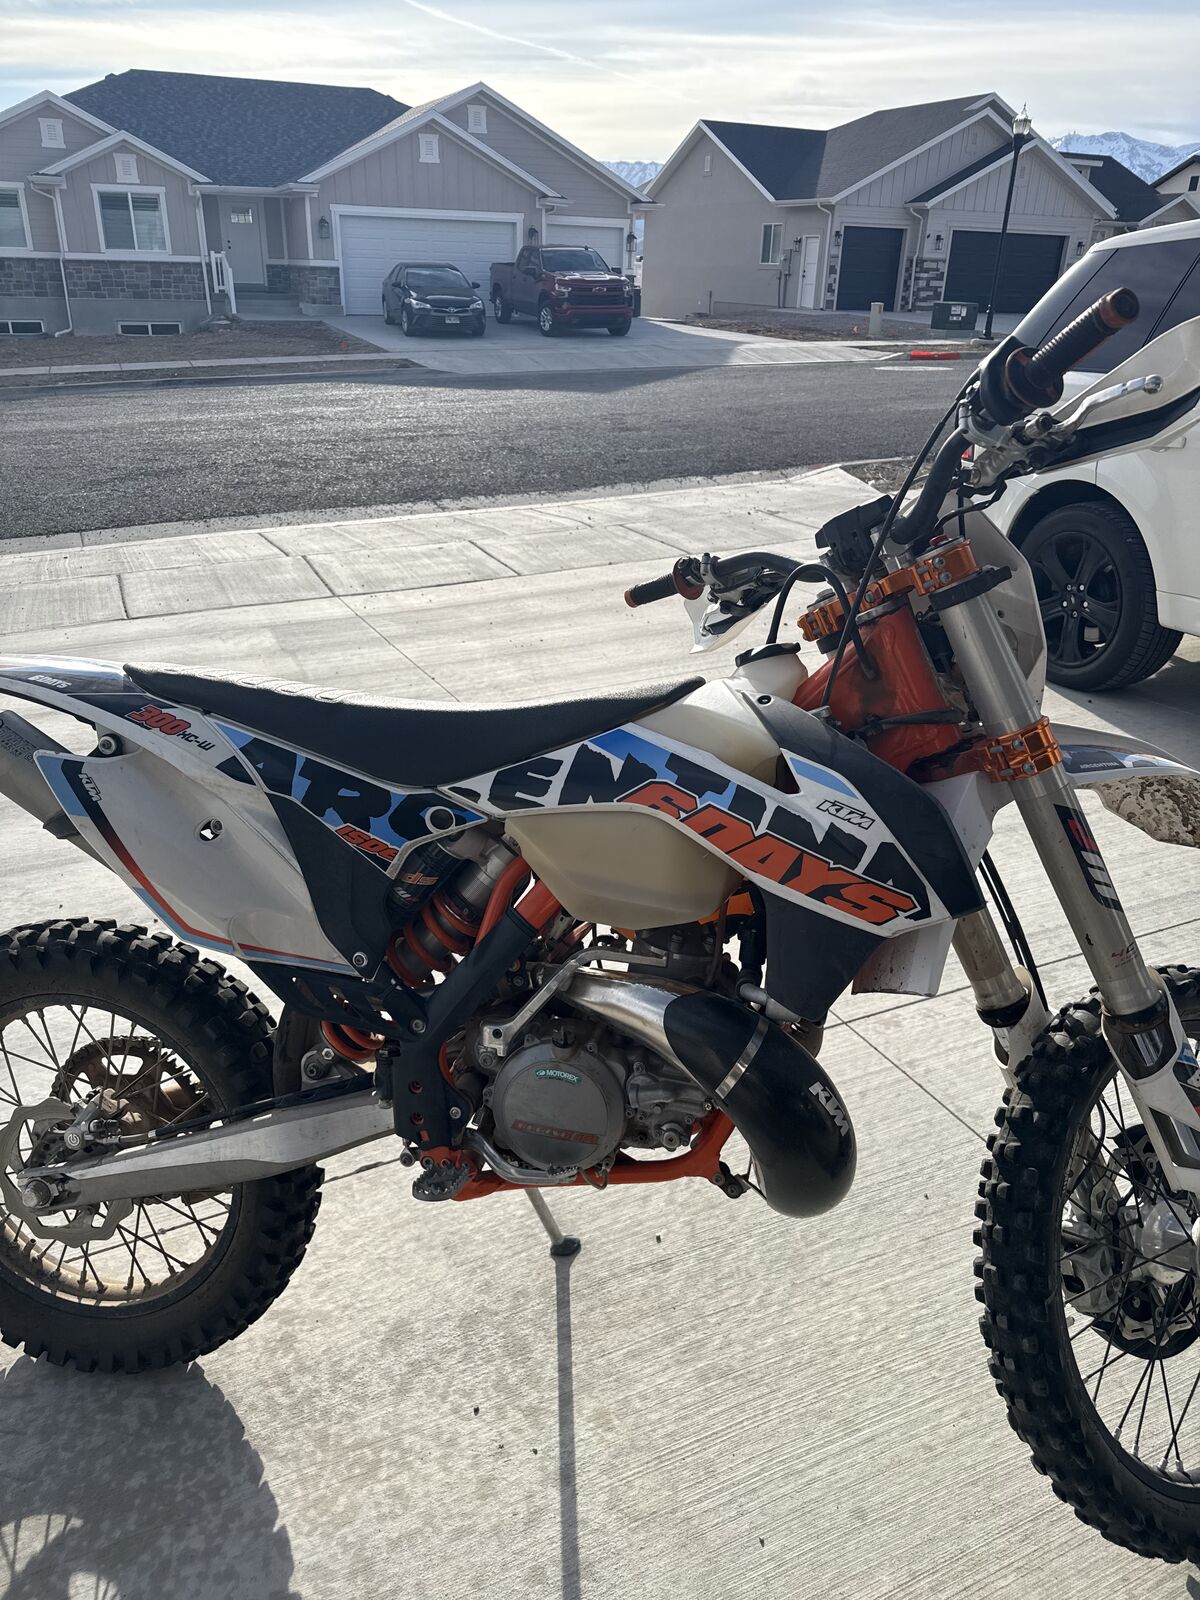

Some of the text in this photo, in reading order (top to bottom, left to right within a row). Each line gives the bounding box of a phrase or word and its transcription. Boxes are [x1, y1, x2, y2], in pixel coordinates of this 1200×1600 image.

[124, 704, 216, 751] 300 XC-W
[78, 772, 103, 802] KTM
[816, 799, 875, 830] KTM
[546, 1069, 580, 1083] MOTOREX
[808, 1081, 850, 1136] KTM
